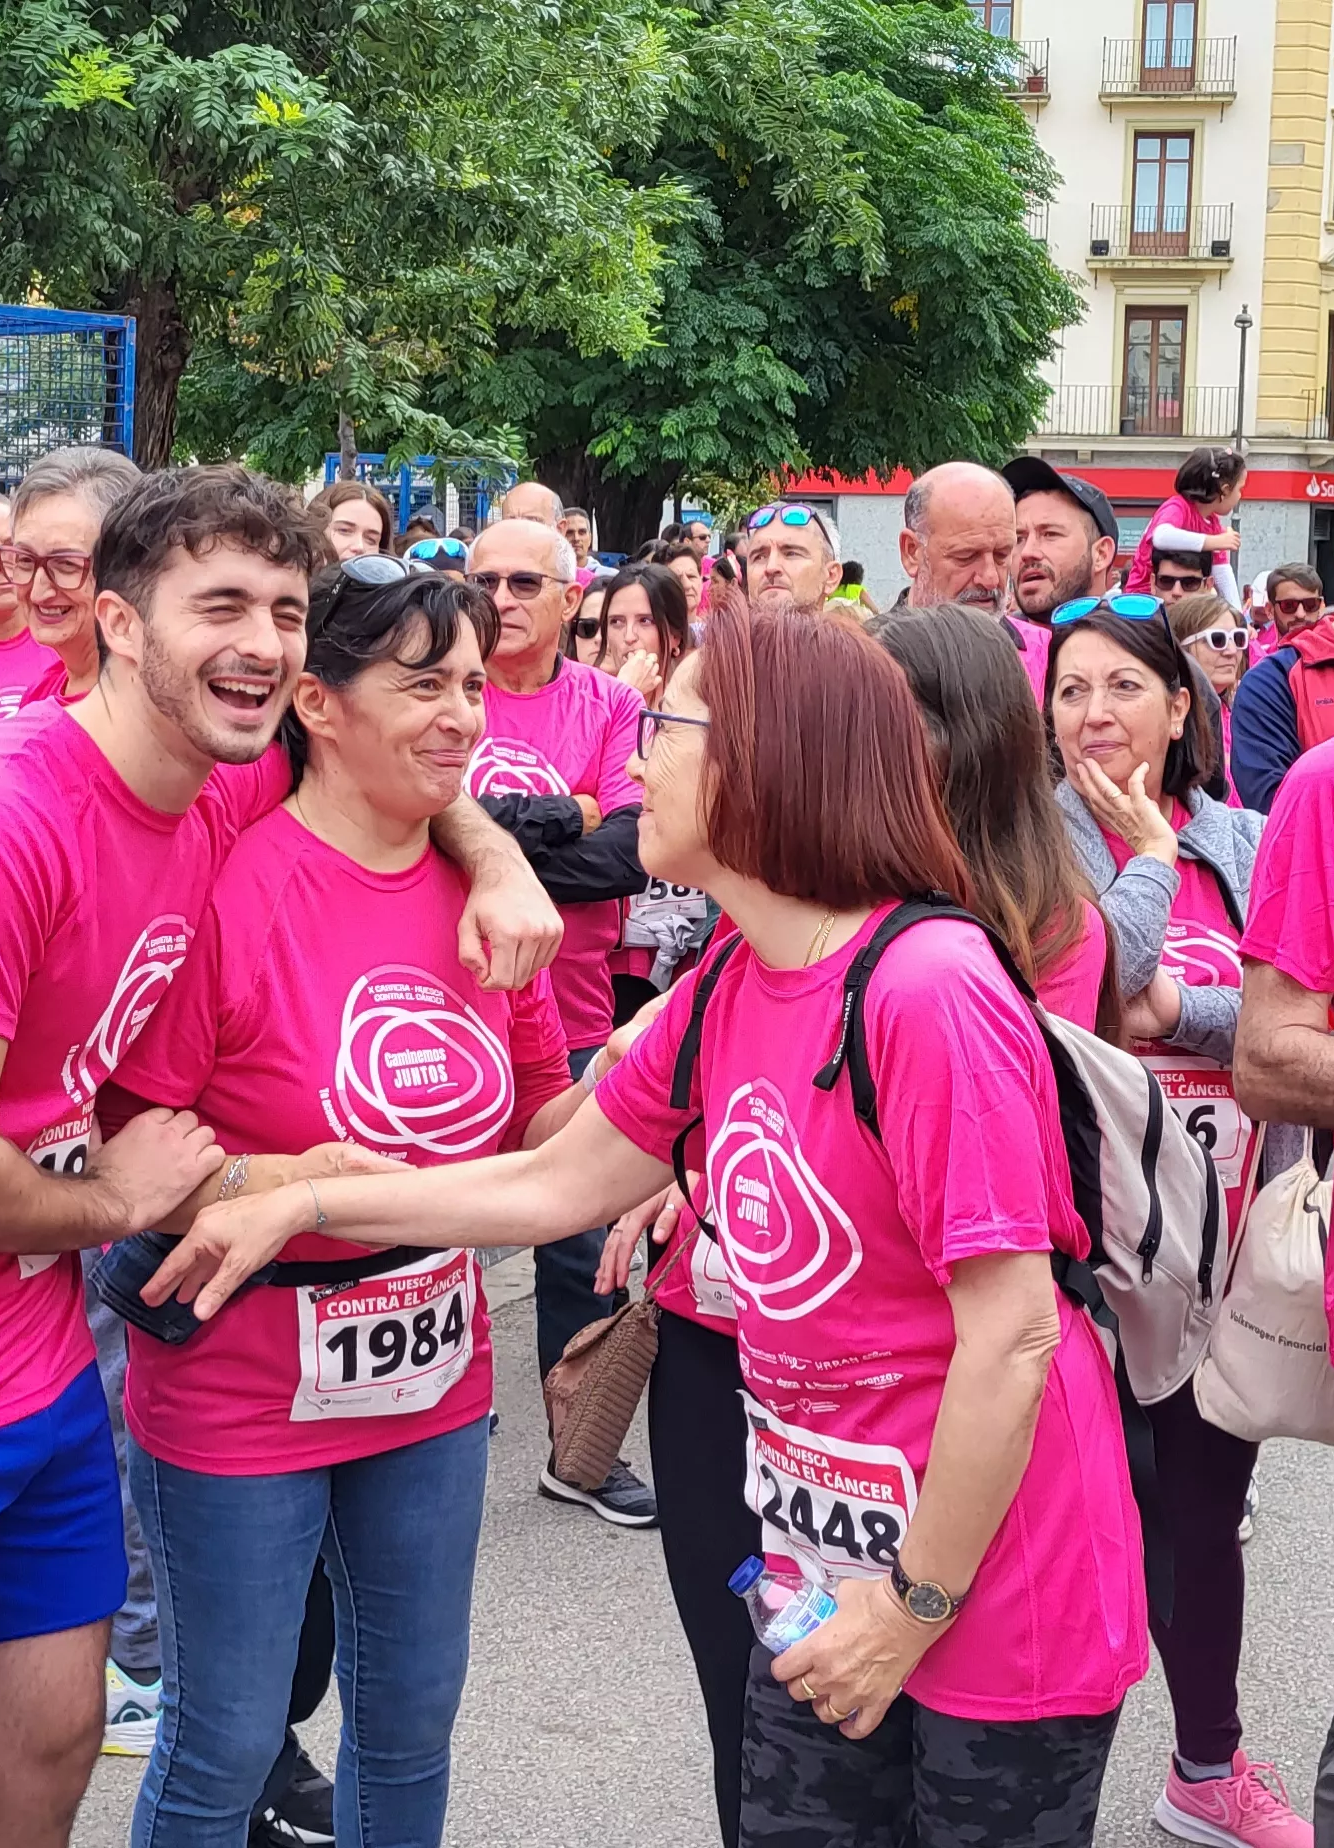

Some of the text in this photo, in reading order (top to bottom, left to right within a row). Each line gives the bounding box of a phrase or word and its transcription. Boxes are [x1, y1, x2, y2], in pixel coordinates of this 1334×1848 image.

[384, 1048, 447, 1069] Caminemos
[393, 1065, 449, 1088] JUNTOS
[1178, 1081, 1229, 1096] CÁNCER
[1170, 1104, 1217, 1152] 6
[388, 1274, 433, 1293] HUESCA
[327, 1296, 399, 1317] CONTRA
[403, 1291, 420, 1306] EL
[326, 1291, 465, 1383] 1984
[1230, 1309, 1327, 1352] Volkswagen Financial
[786, 1443, 829, 1469] HUESCA
[802, 1465, 820, 1484] EL
[824, 1471, 895, 1501] CÁNCER
[760, 1464, 901, 1566] 2448
